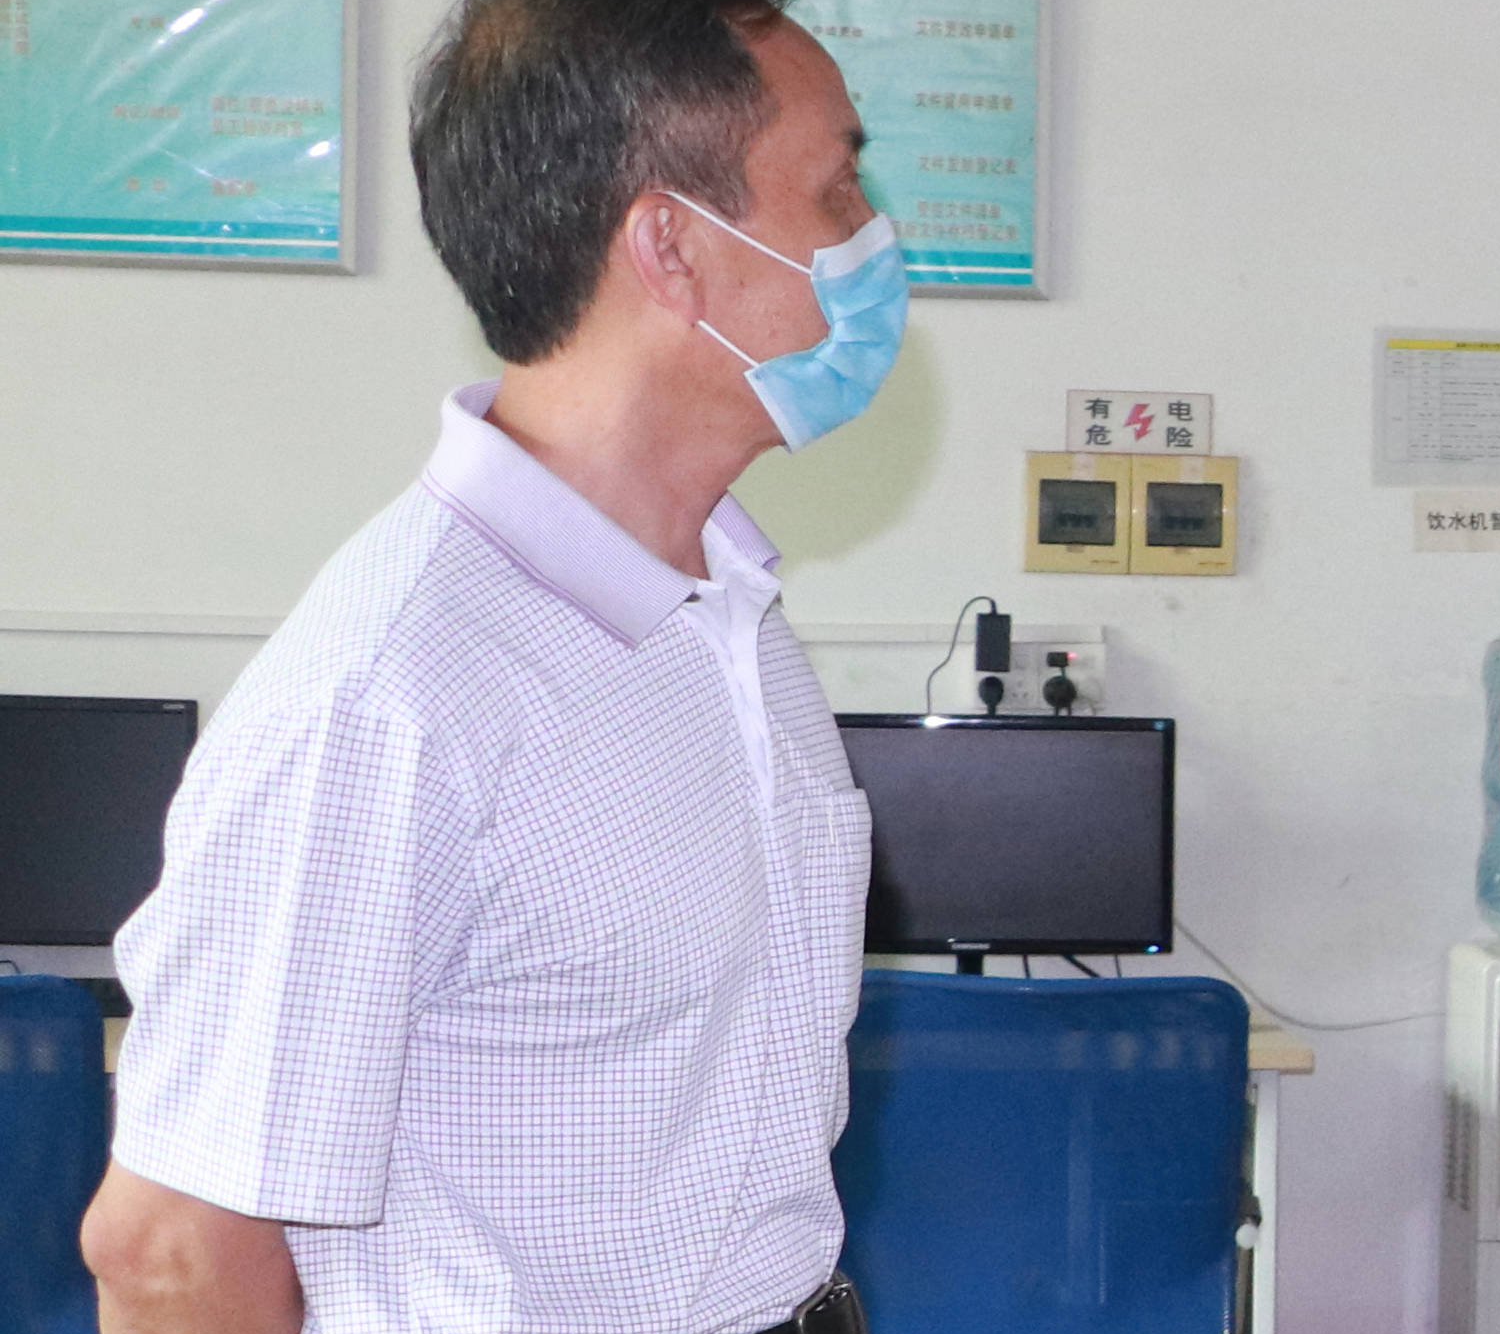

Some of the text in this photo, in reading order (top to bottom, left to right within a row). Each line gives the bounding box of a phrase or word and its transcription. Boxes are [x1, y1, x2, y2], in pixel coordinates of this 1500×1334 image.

[1084, 397, 1193, 422] 有 电
[1084, 423, 1193, 448] 危 险
